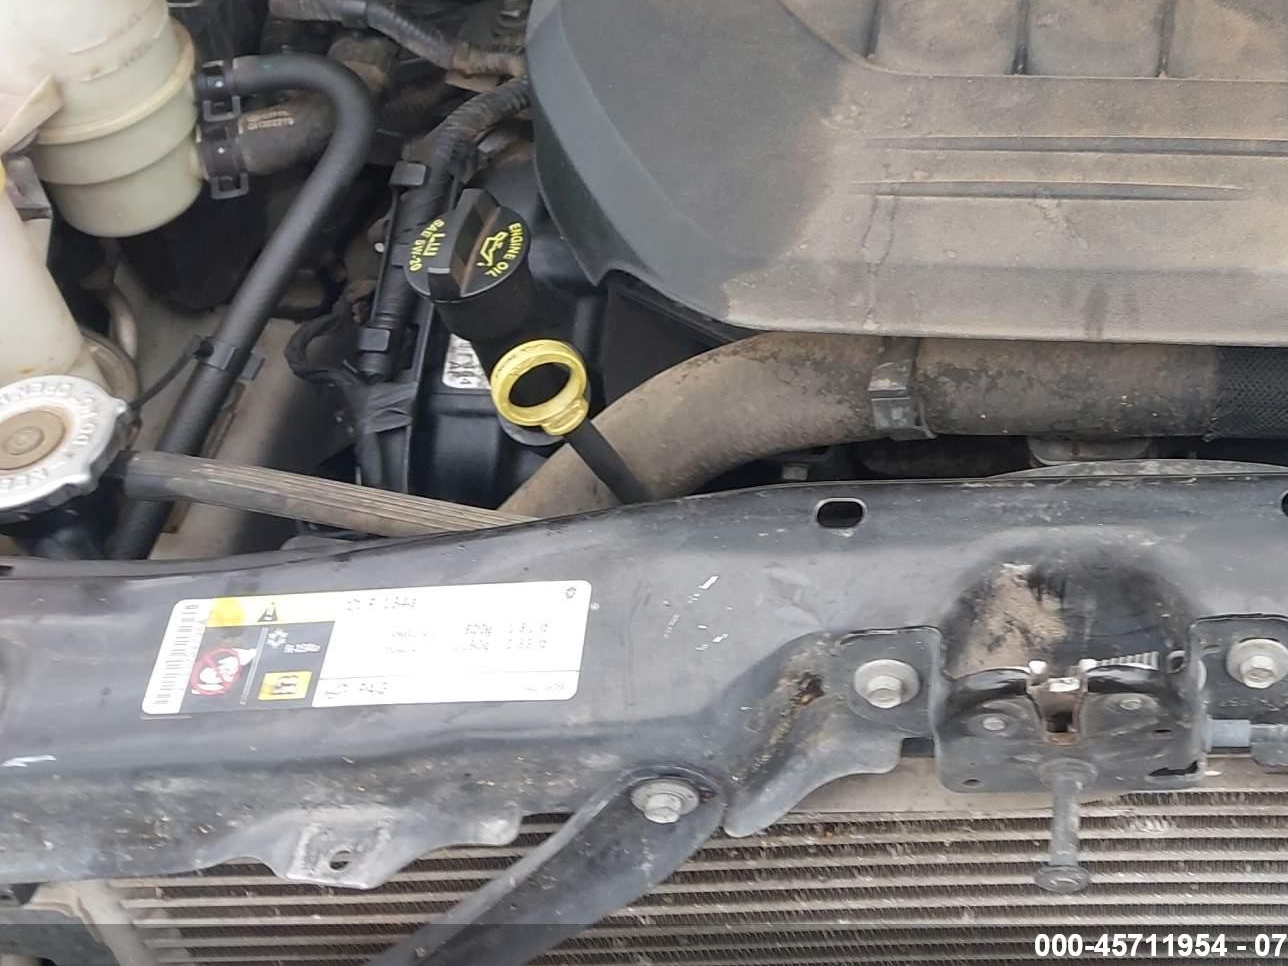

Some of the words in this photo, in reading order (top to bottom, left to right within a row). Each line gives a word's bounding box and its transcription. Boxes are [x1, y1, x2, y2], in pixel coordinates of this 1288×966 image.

[420, 218, 445, 238] SAE
[503, 222, 523, 260] ENGINE
[485, 261, 509, 277] OIL
